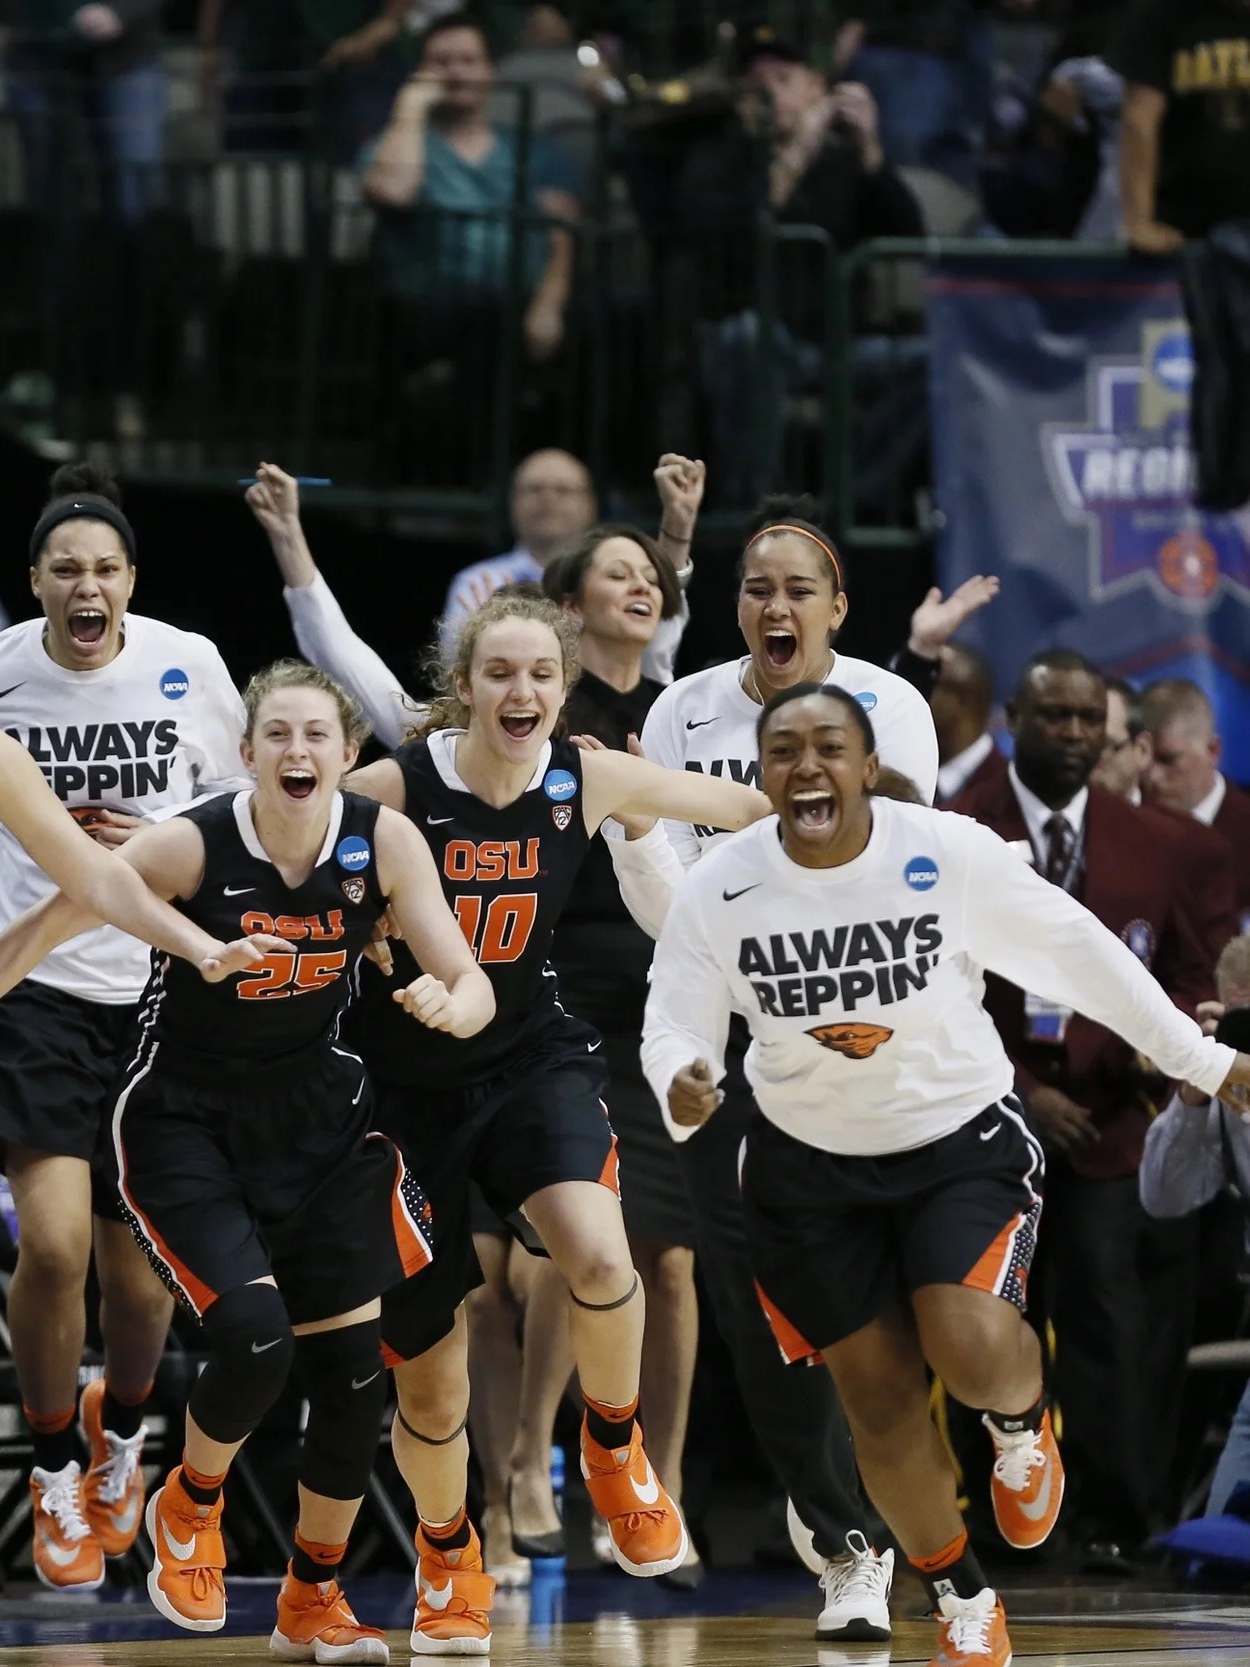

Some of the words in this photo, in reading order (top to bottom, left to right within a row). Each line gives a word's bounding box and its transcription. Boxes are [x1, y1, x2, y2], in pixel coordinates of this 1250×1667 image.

[41, 756, 177, 802] PPIN'
[548, 780, 575, 794] NCAA
[342, 850, 370, 864] NCAA
[443, 837, 540, 881] OSU
[908, 871, 938, 882] NCAA
[240, 909, 345, 940] OSU
[454, 892, 538, 963] 10
[738, 913, 943, 976] ALWAYS
[236, 949, 347, 1000] 25
[750, 953, 939, 1017] REPPIN'
